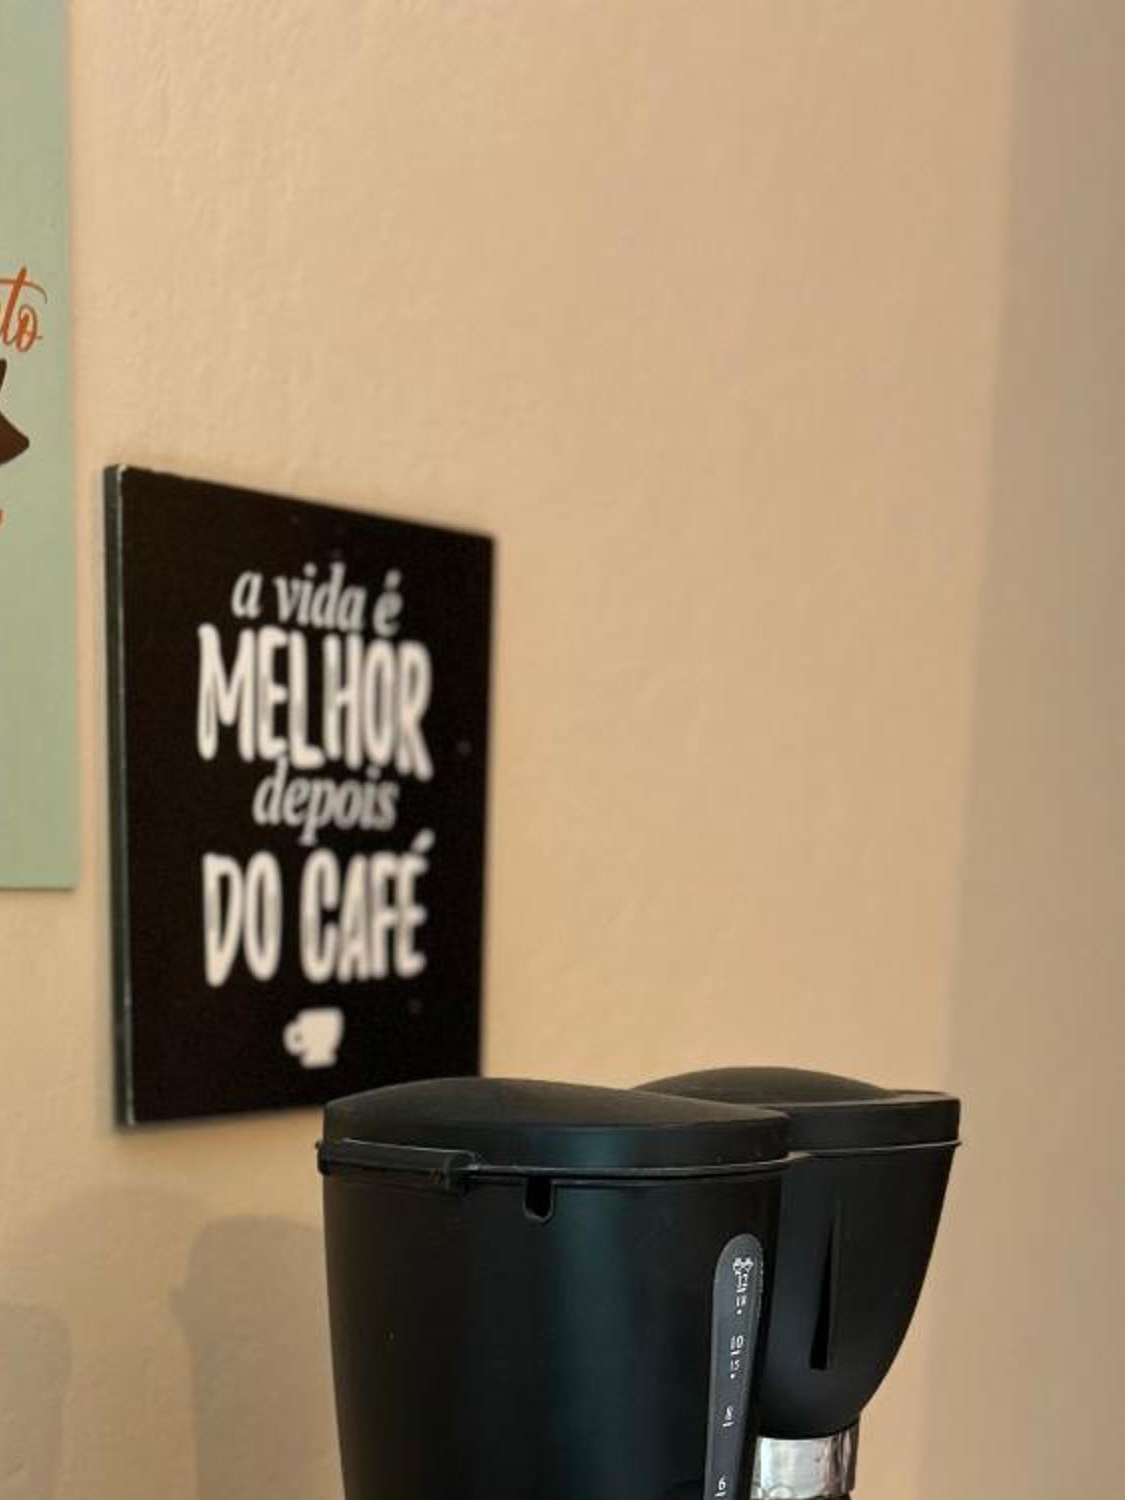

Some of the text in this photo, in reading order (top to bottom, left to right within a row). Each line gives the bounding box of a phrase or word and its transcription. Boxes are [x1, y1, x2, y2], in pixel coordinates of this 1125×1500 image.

[232, 560, 404, 636] a vida é
[197, 622, 434, 782] MELHOR
[252, 742, 400, 846] depois
[203, 828, 436, 988] DO CAFÉ
